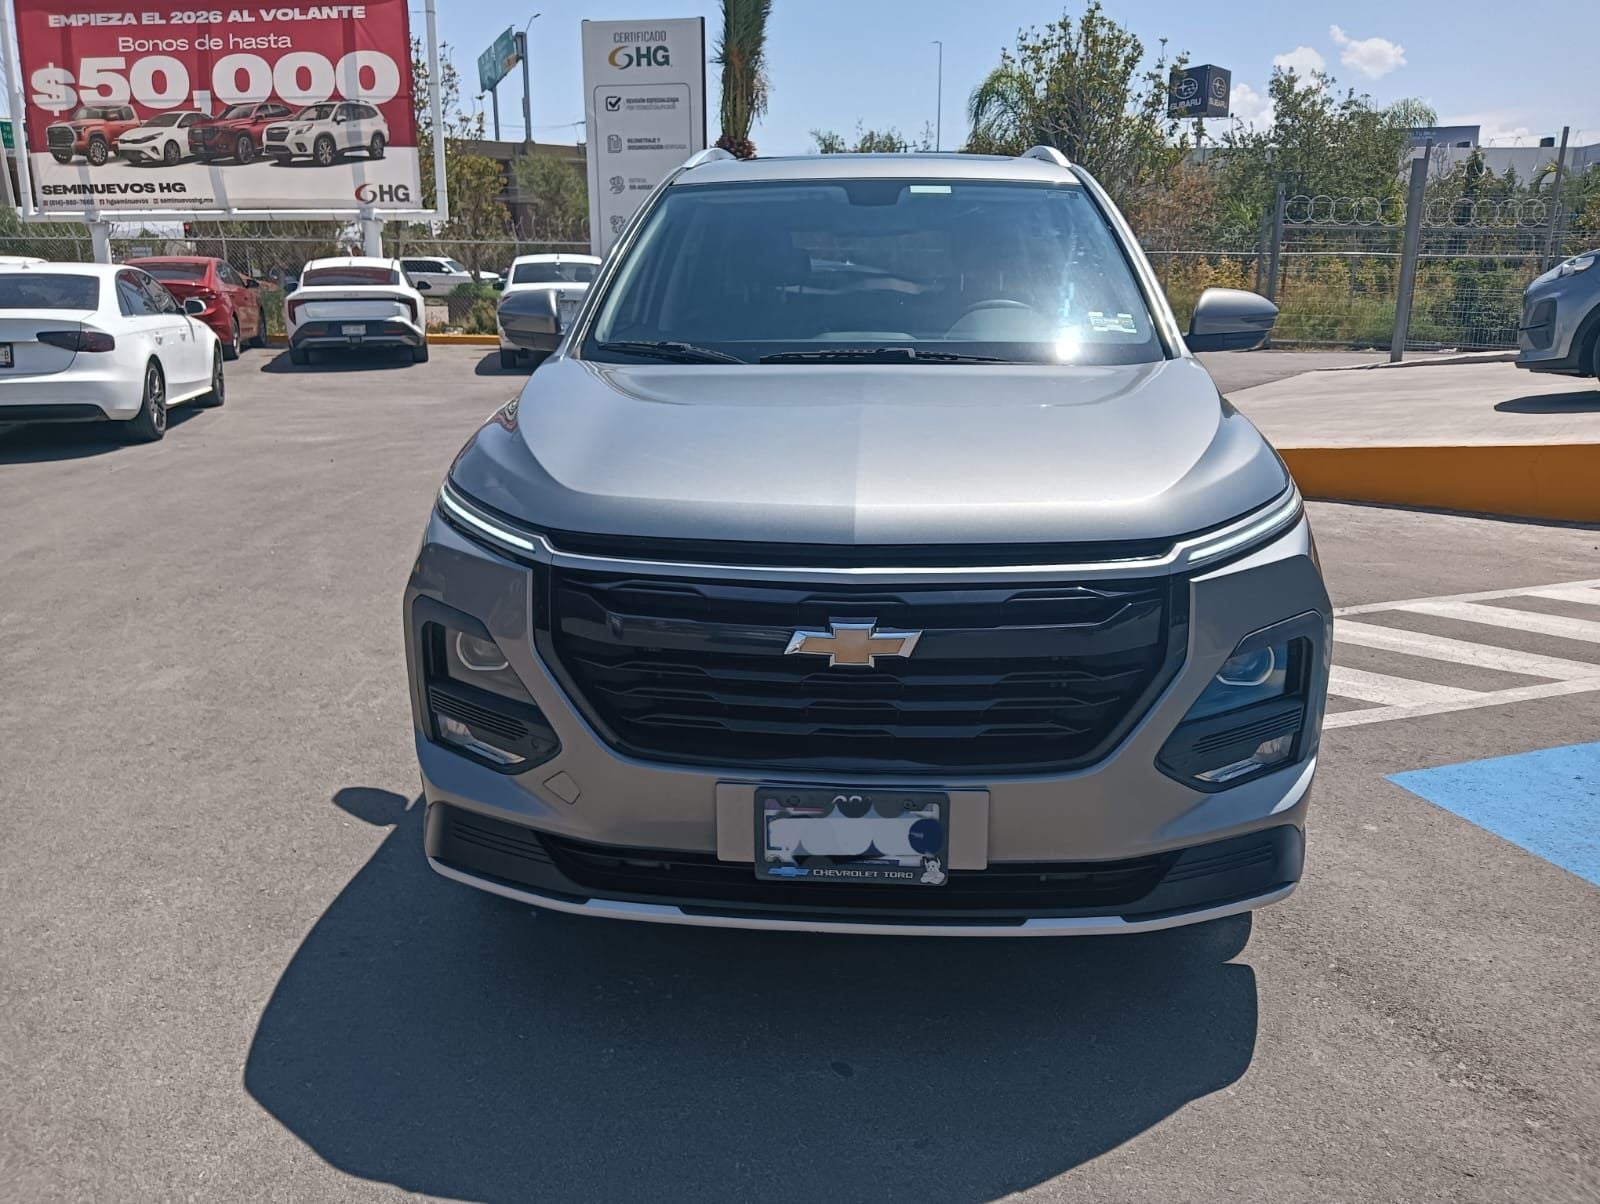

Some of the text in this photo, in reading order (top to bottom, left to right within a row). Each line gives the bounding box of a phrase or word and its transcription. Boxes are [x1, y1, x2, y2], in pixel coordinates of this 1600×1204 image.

[48, 5, 366, 28] EMPIEZA EL 2026 AL VOLANTE
[118, 33, 292, 52] Bonos de hasta
[613, 30, 667, 43] CERTIFICADO
[635, 45, 671, 67] HG
[31, 50, 401, 117] $50,000
[1169, 97, 1202, 110] SUBARU
[41, 182, 187, 195] SEMINUEVOS HG
[378, 184, 410, 203] HG
[812, 868, 914, 879] CHEVROLET TORO
